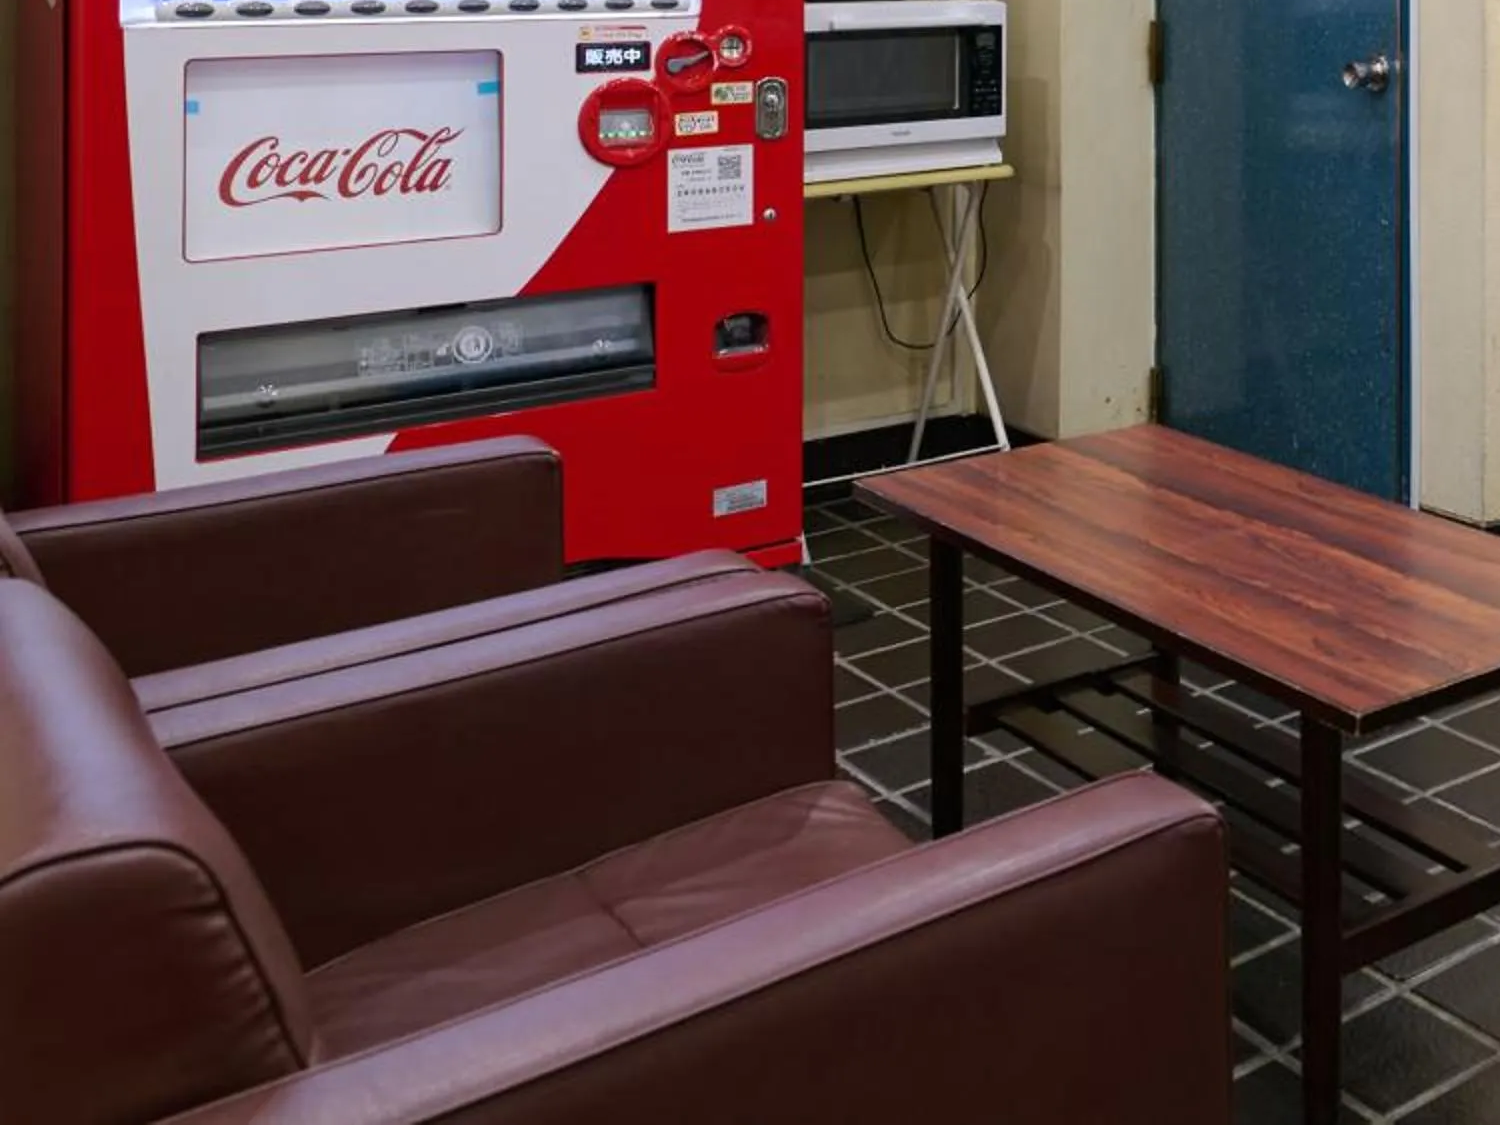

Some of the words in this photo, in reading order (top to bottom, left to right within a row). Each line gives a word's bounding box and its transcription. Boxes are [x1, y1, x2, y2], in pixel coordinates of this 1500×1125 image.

[584, 48, 642, 66] 販売中
[218, 125, 465, 208] Coca-Cola
